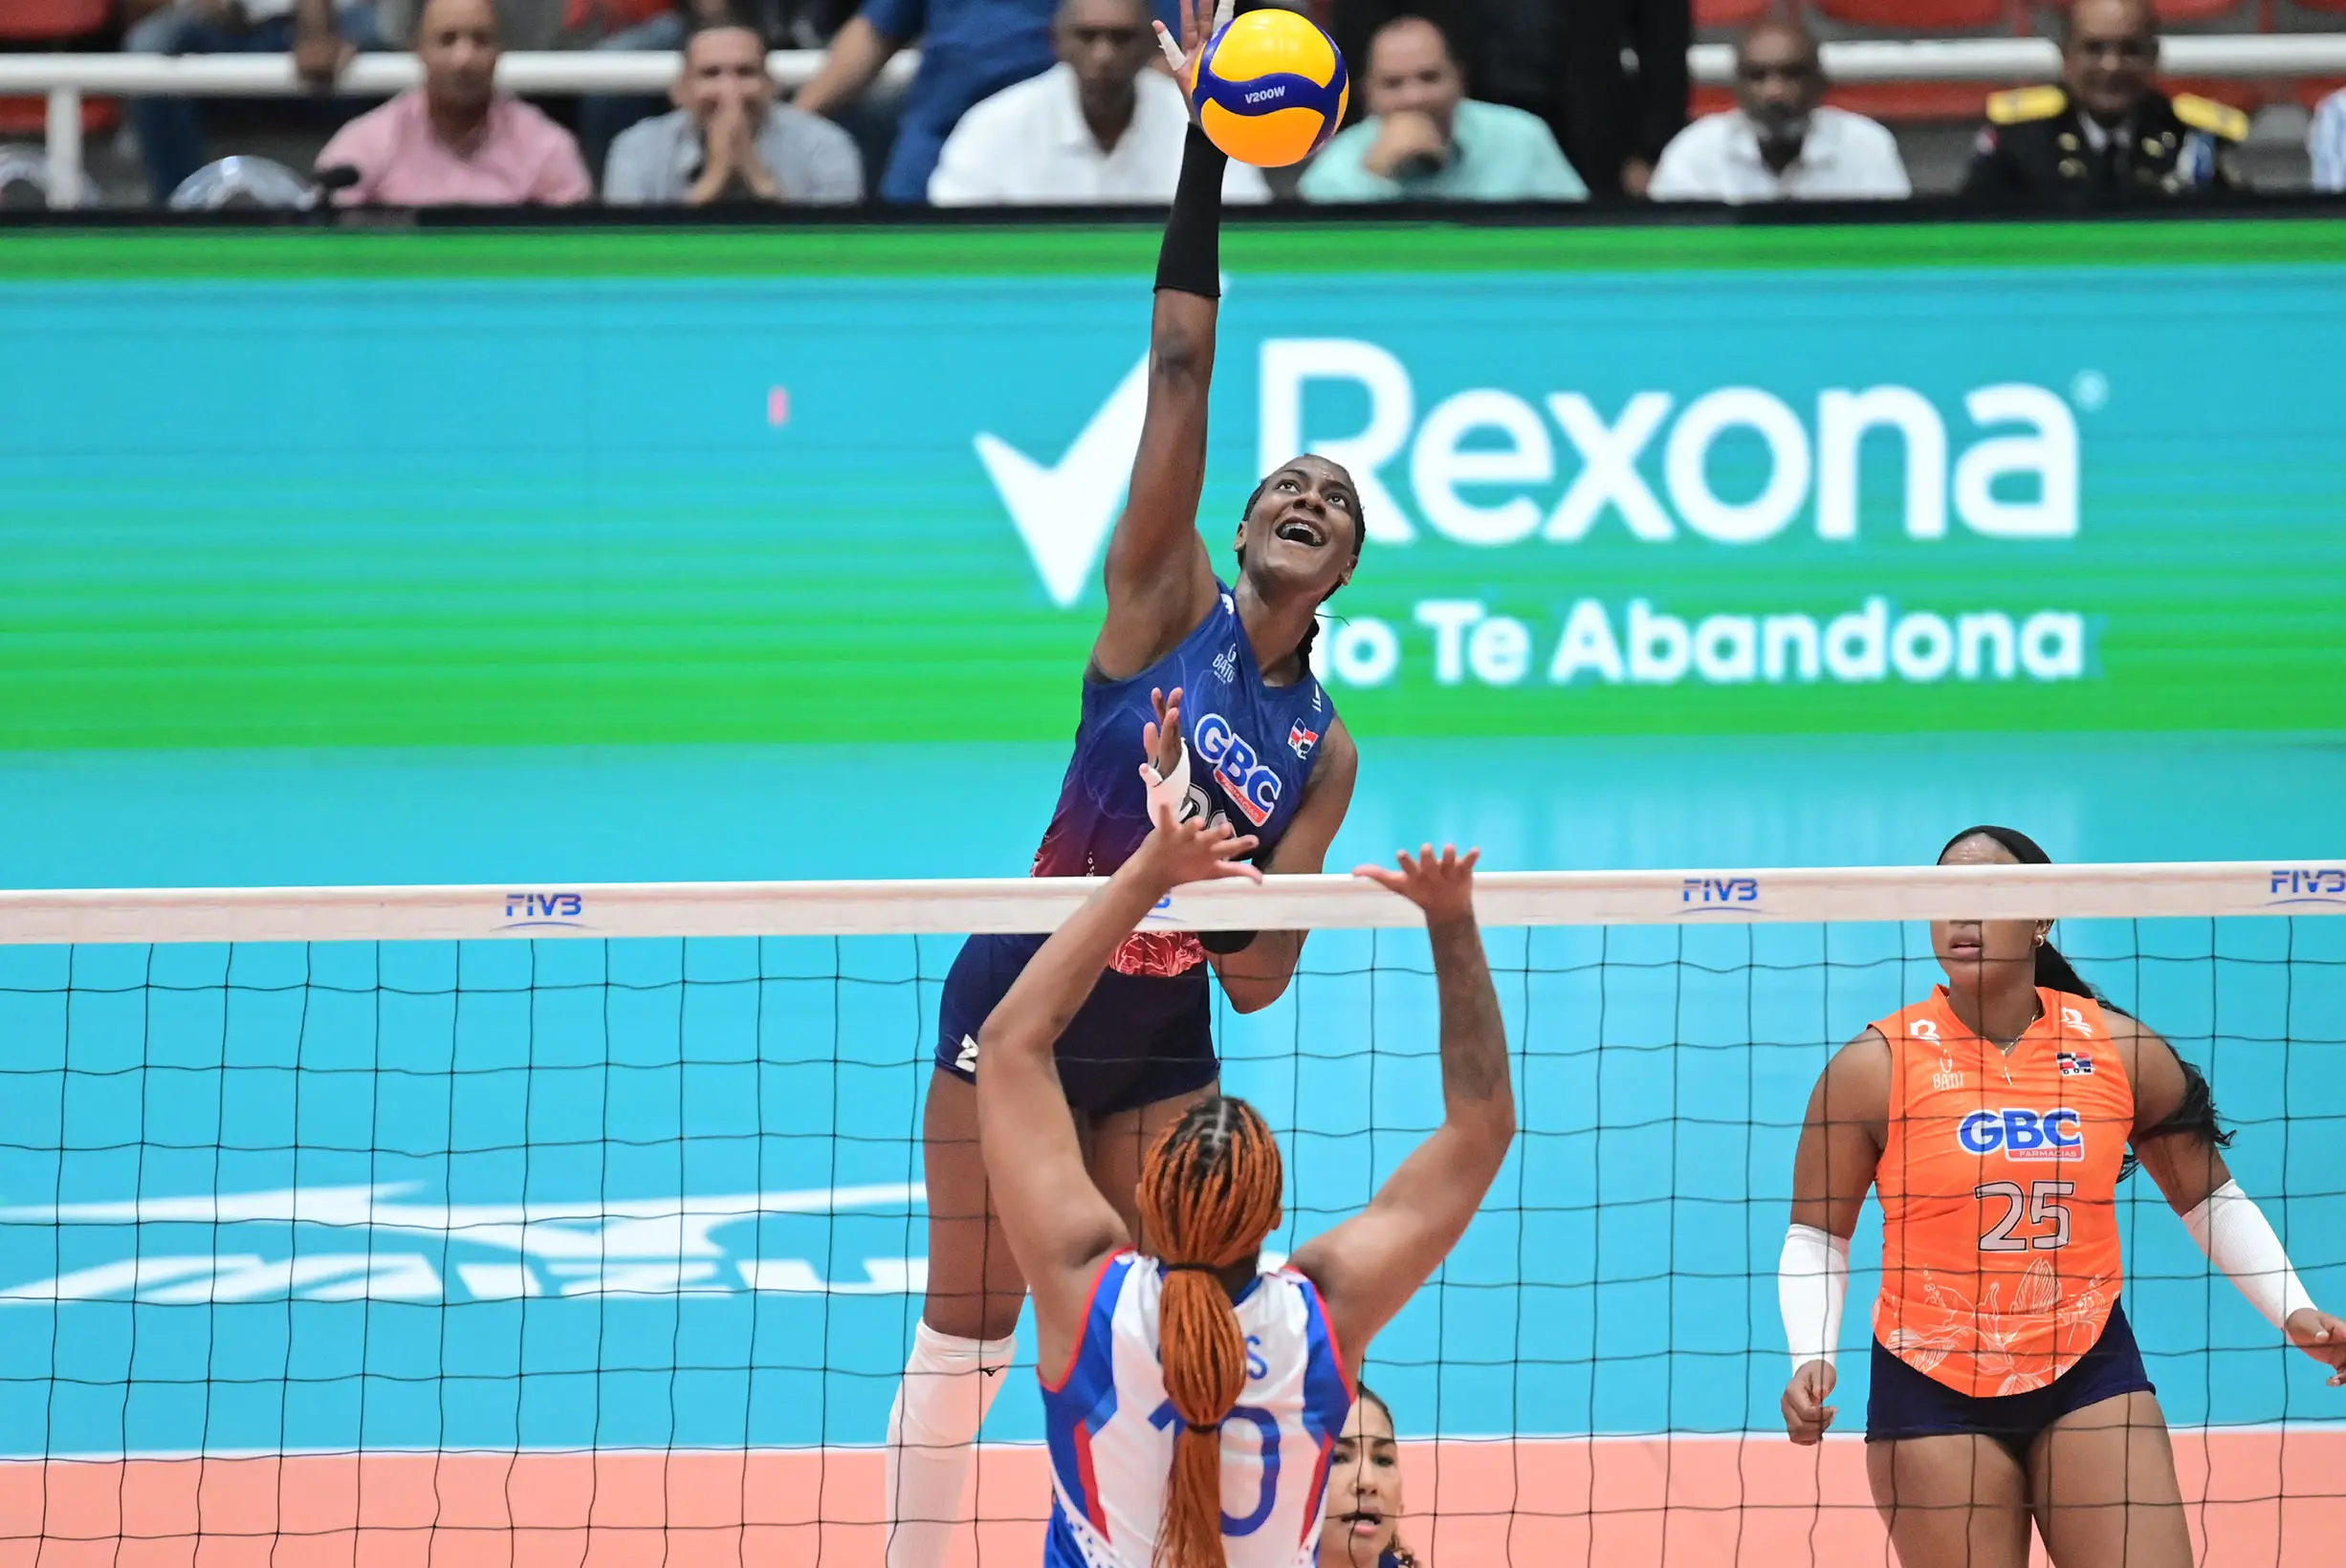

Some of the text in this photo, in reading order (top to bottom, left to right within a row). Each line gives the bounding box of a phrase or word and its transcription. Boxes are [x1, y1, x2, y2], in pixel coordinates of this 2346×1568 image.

[1244, 85, 1285, 104] V200W
[1259, 338, 2080, 545] Rexona
[1415, 600, 1532, 685] Te
[1549, 596, 2086, 685] Abandona
[1195, 713, 1282, 815] GBC
[506, 893, 581, 916] FIVB
[1683, 878, 1758, 902] FIVB
[2271, 870, 2346, 893] FIVB
[1958, 1108, 2082, 1154] GBC
[1974, 1181, 2075, 1252] 25
